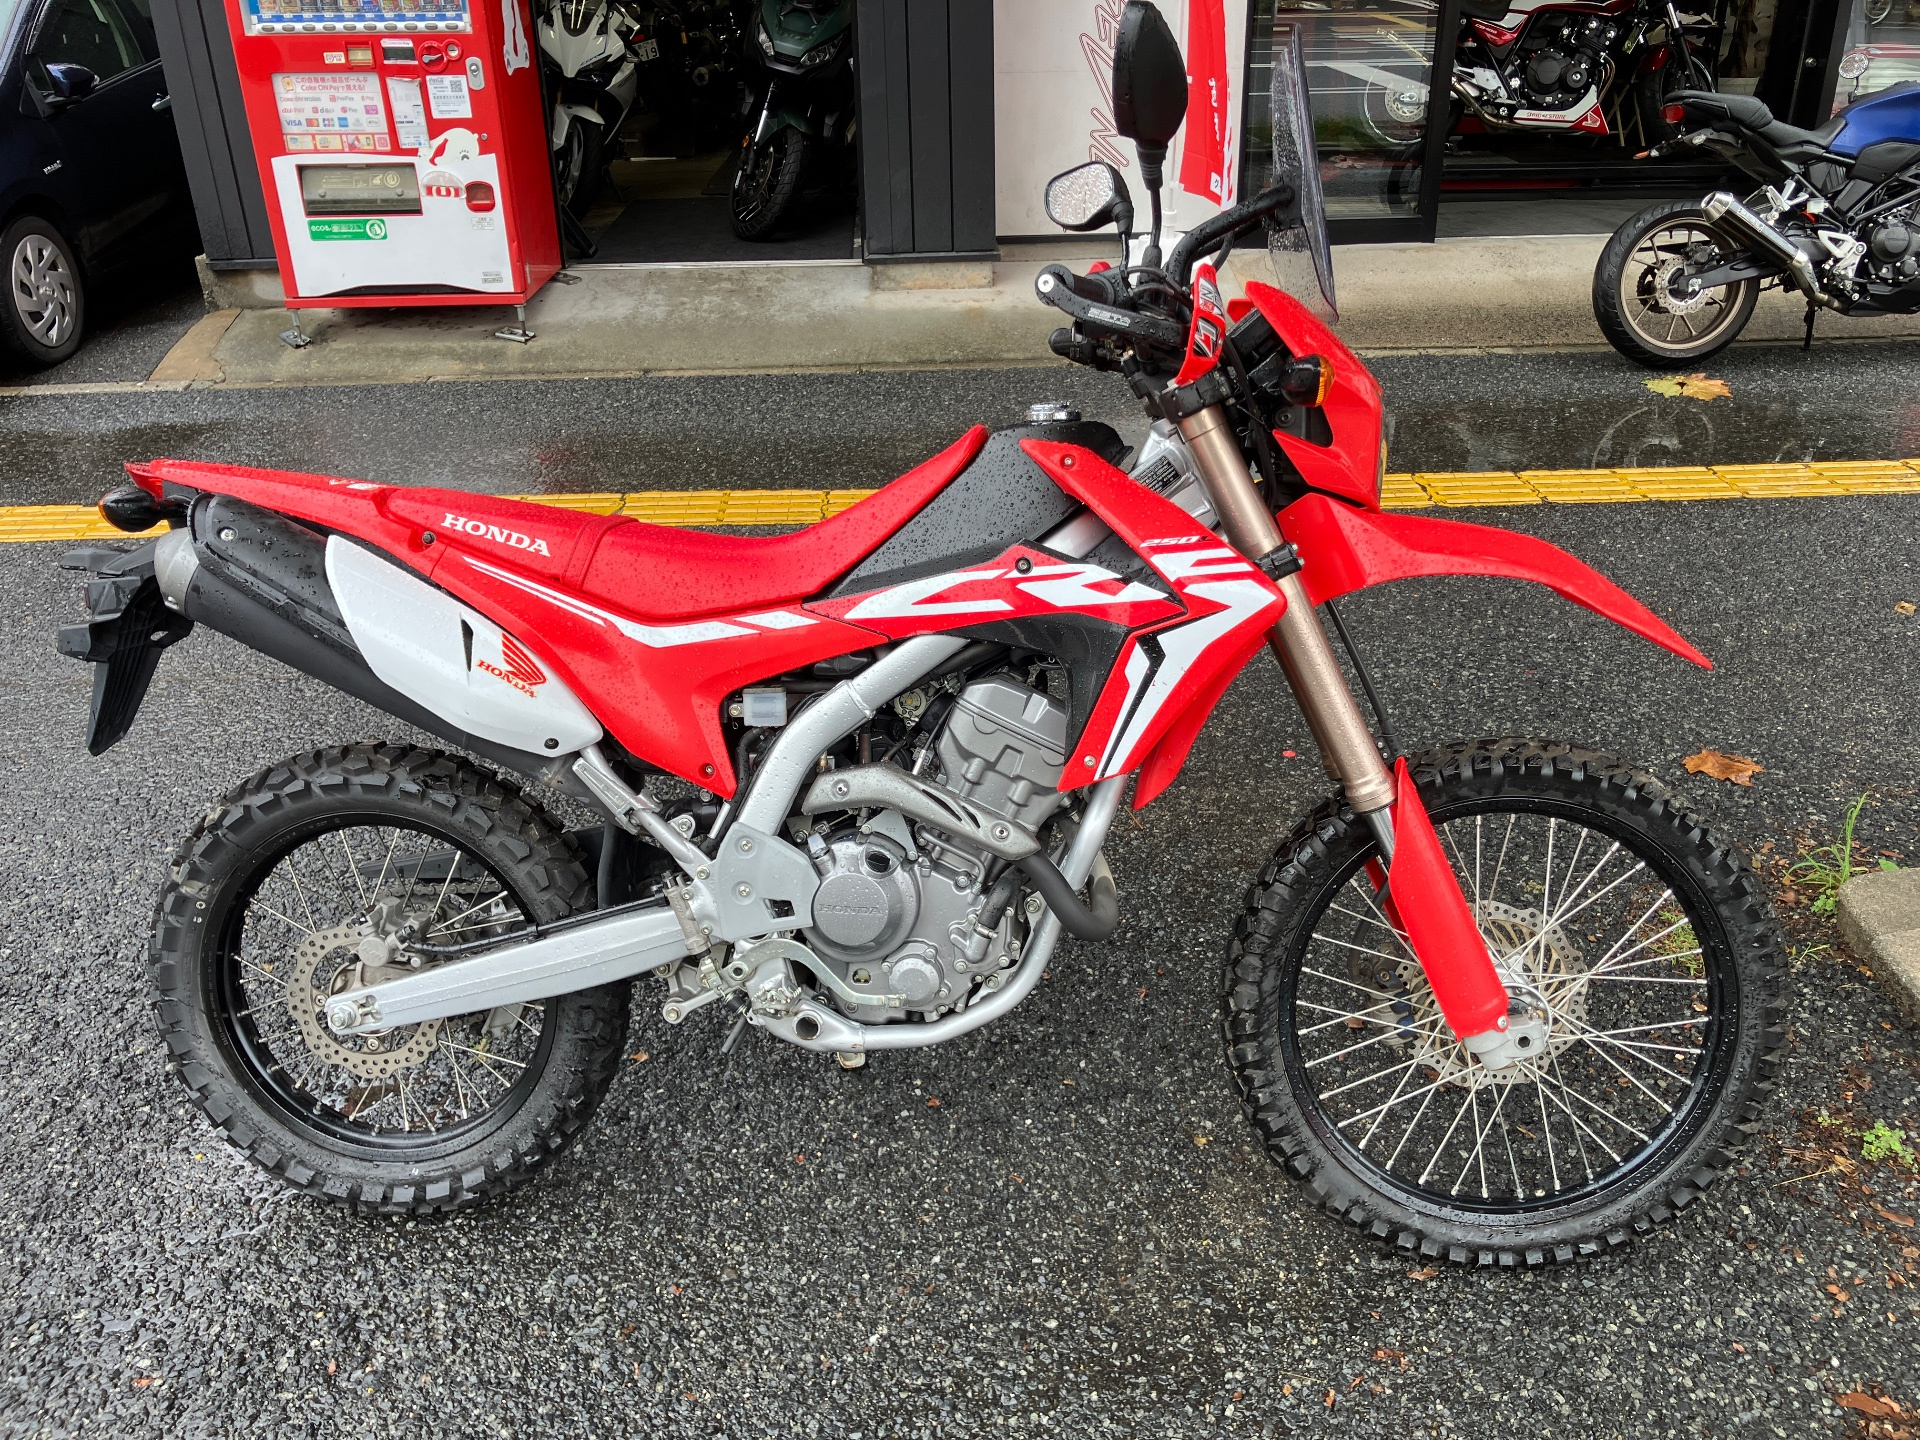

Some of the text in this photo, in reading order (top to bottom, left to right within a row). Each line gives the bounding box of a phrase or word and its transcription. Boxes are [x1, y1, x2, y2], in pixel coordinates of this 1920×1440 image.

[440, 513, 550, 557] HONDA
[476, 659, 538, 698] HONDA
[818, 903, 883, 916] HONDA
